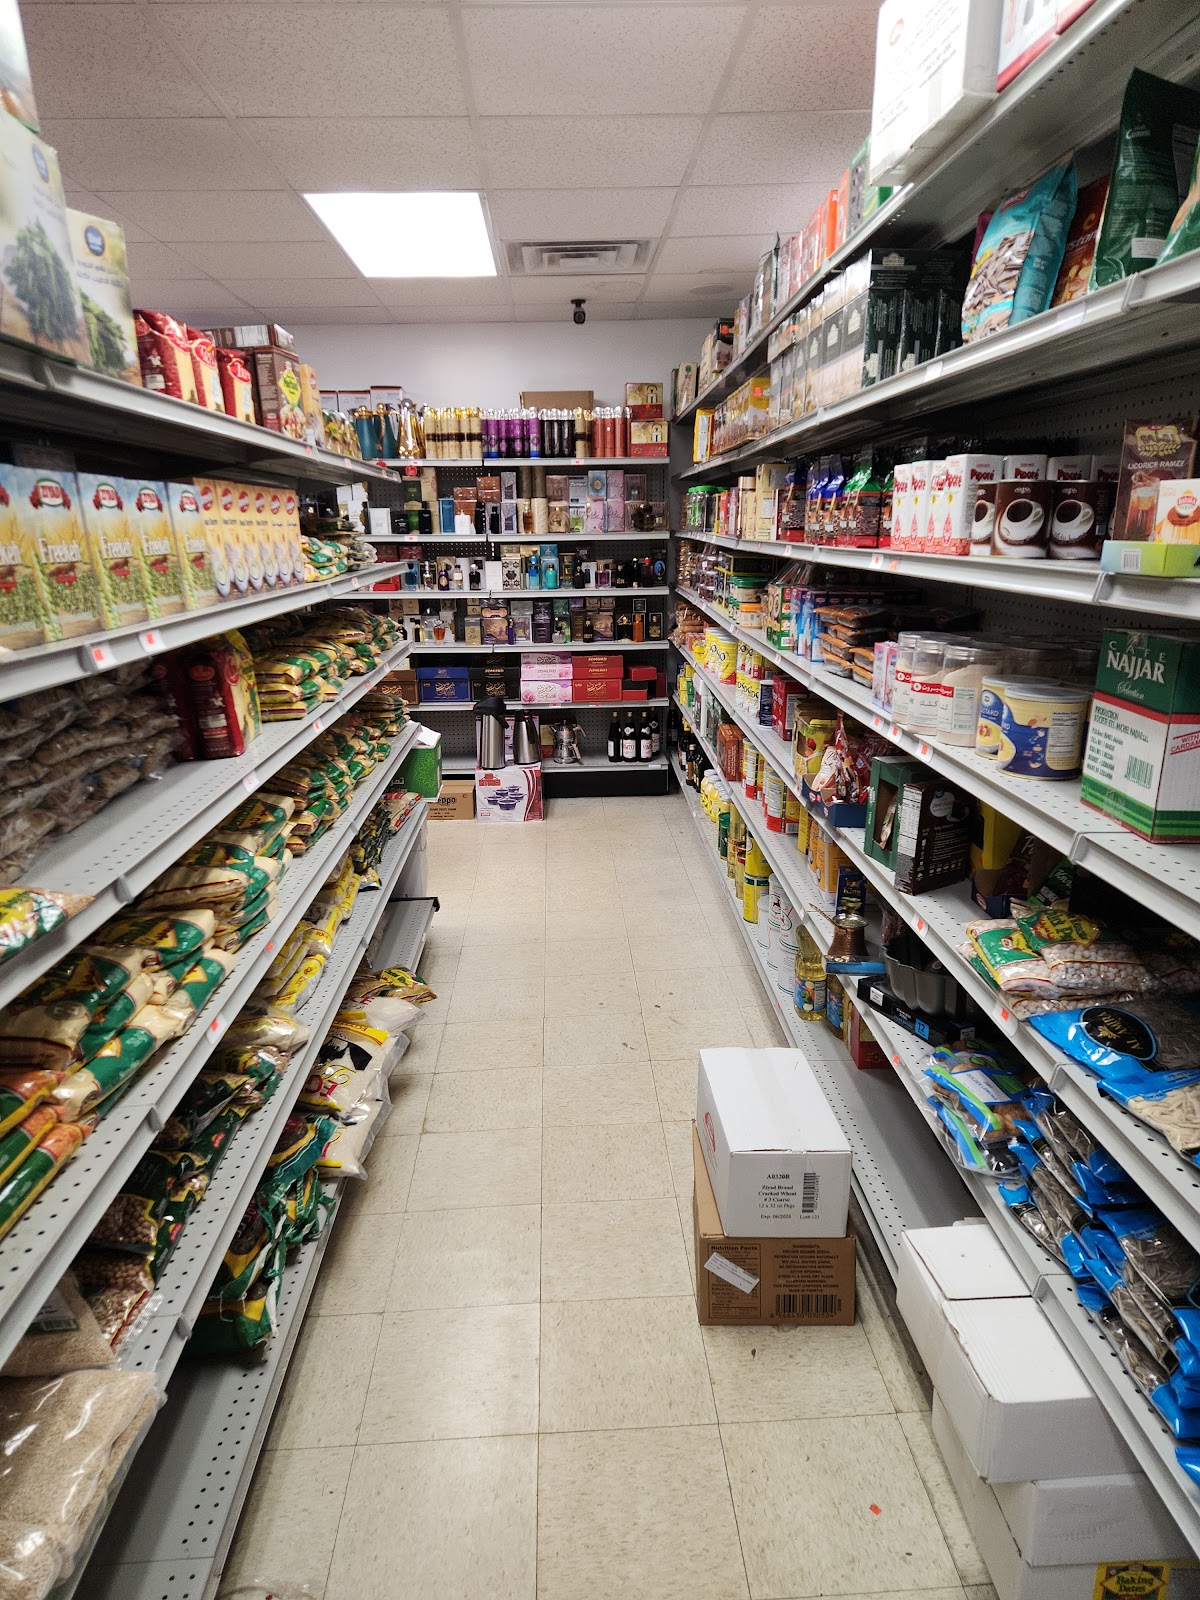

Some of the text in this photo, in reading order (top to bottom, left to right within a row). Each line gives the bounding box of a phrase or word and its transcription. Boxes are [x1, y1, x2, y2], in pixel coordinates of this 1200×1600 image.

[1128, 460, 1185, 470] LICORICE RAMZY
[39, 538, 81, 564] Freekeh
[1106, 650, 1165, 684] NAJJAR
[1117, 681, 1145, 700] Selection
[1181, 734, 1200, 744] WITH
[1170, 740, 1200, 752] CARDAM
[918, 1022, 925, 1033] 12
[1116, 1575, 1153, 1587] Baking
[1120, 1584, 1146, 1593] Dates
